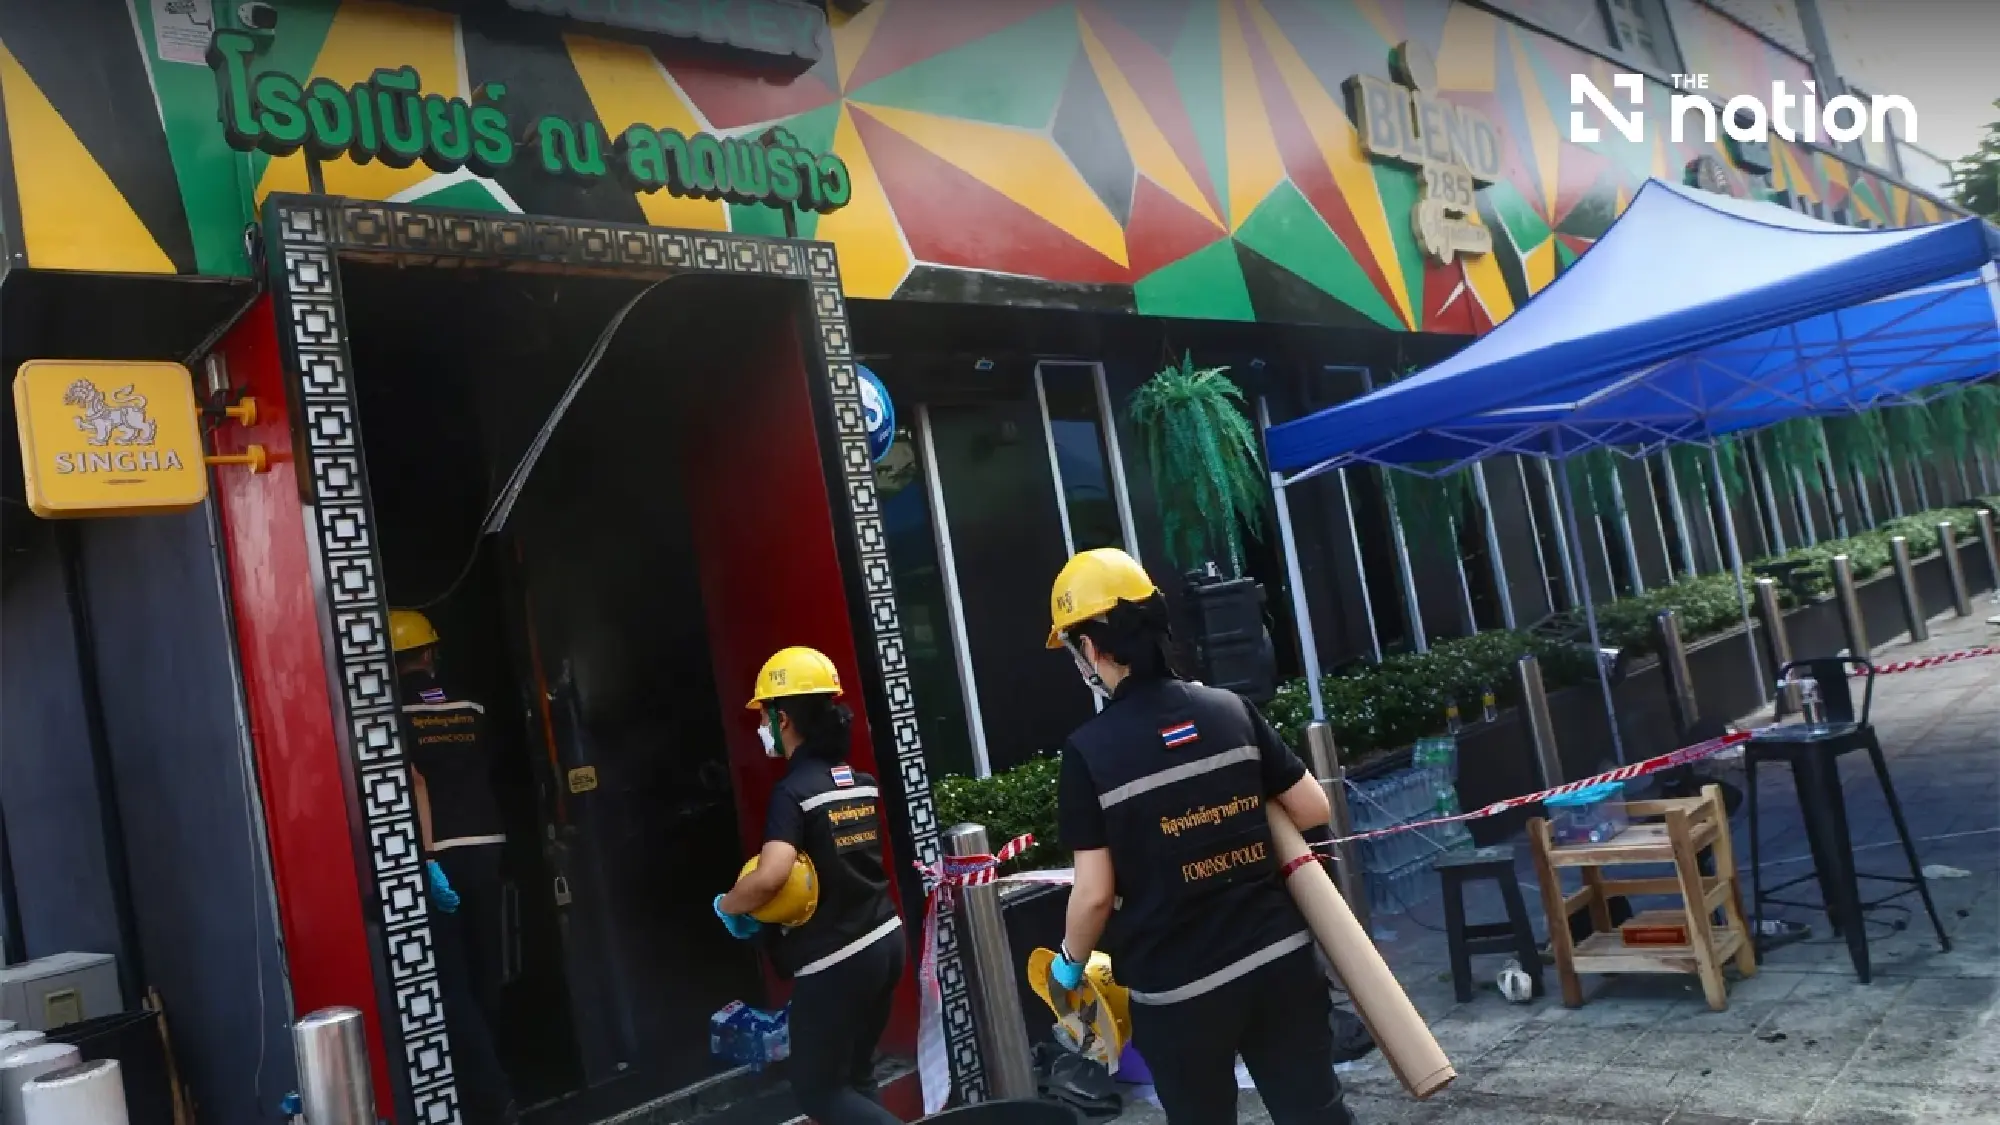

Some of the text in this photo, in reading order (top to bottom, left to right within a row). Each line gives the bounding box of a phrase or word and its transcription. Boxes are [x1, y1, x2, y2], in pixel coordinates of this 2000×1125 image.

[216, 33, 851, 205] โรงเบียร์ ณ ลาดพร้าว
[1367, 86, 1500, 177] BLEND
[1428, 168, 1471, 206] 285
[55, 449, 184, 475] SINGHA
